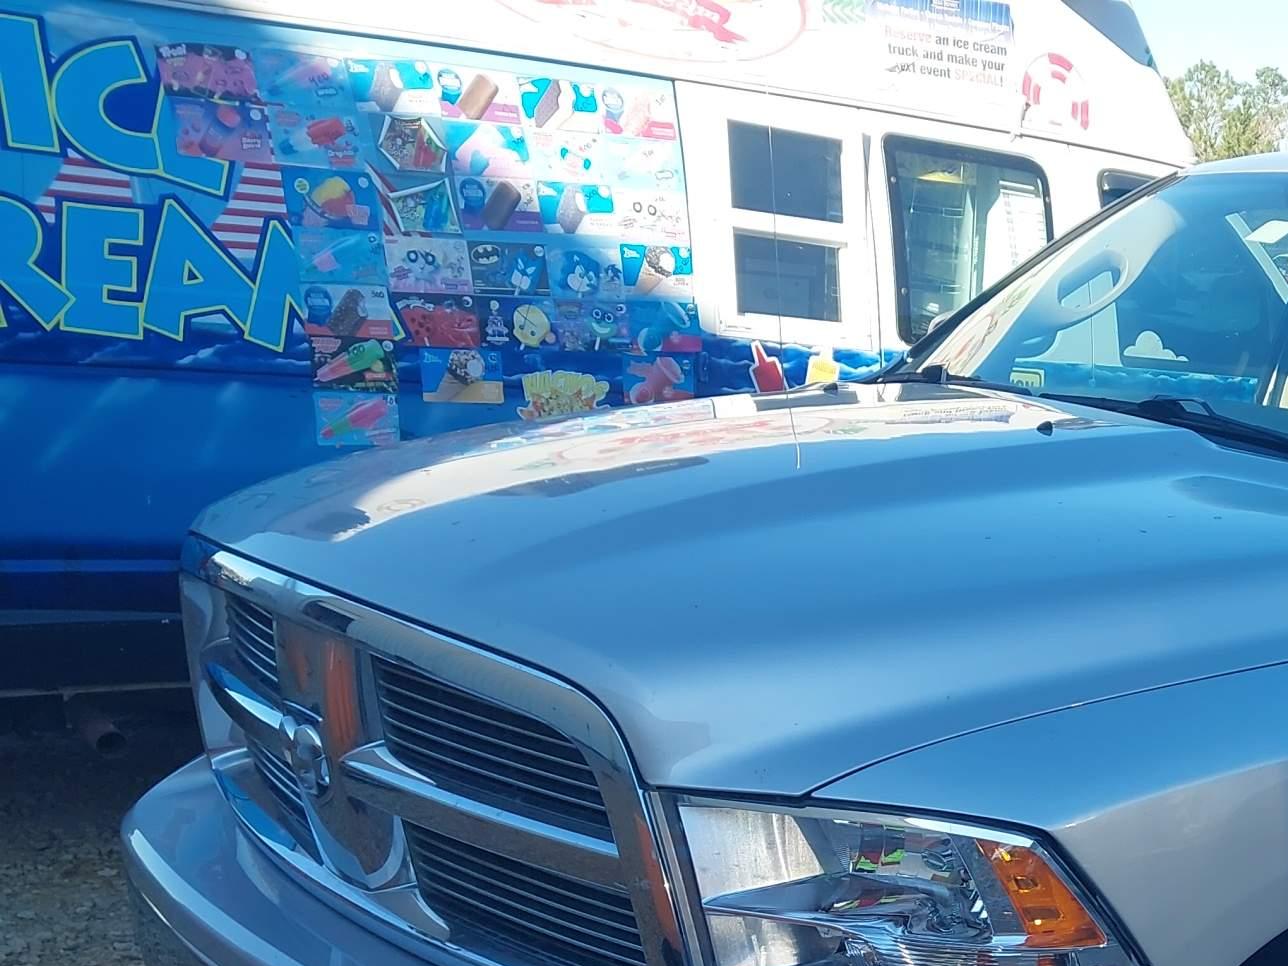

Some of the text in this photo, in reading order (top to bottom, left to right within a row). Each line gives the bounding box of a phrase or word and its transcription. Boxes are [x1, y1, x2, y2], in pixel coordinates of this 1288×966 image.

[935, 35, 949, 46] an
[952, 37, 969, 50] ice
[973, 42, 1008, 57] cream
[888, 43, 1006, 72] truck and make your
[920, 63, 951, 79] event
